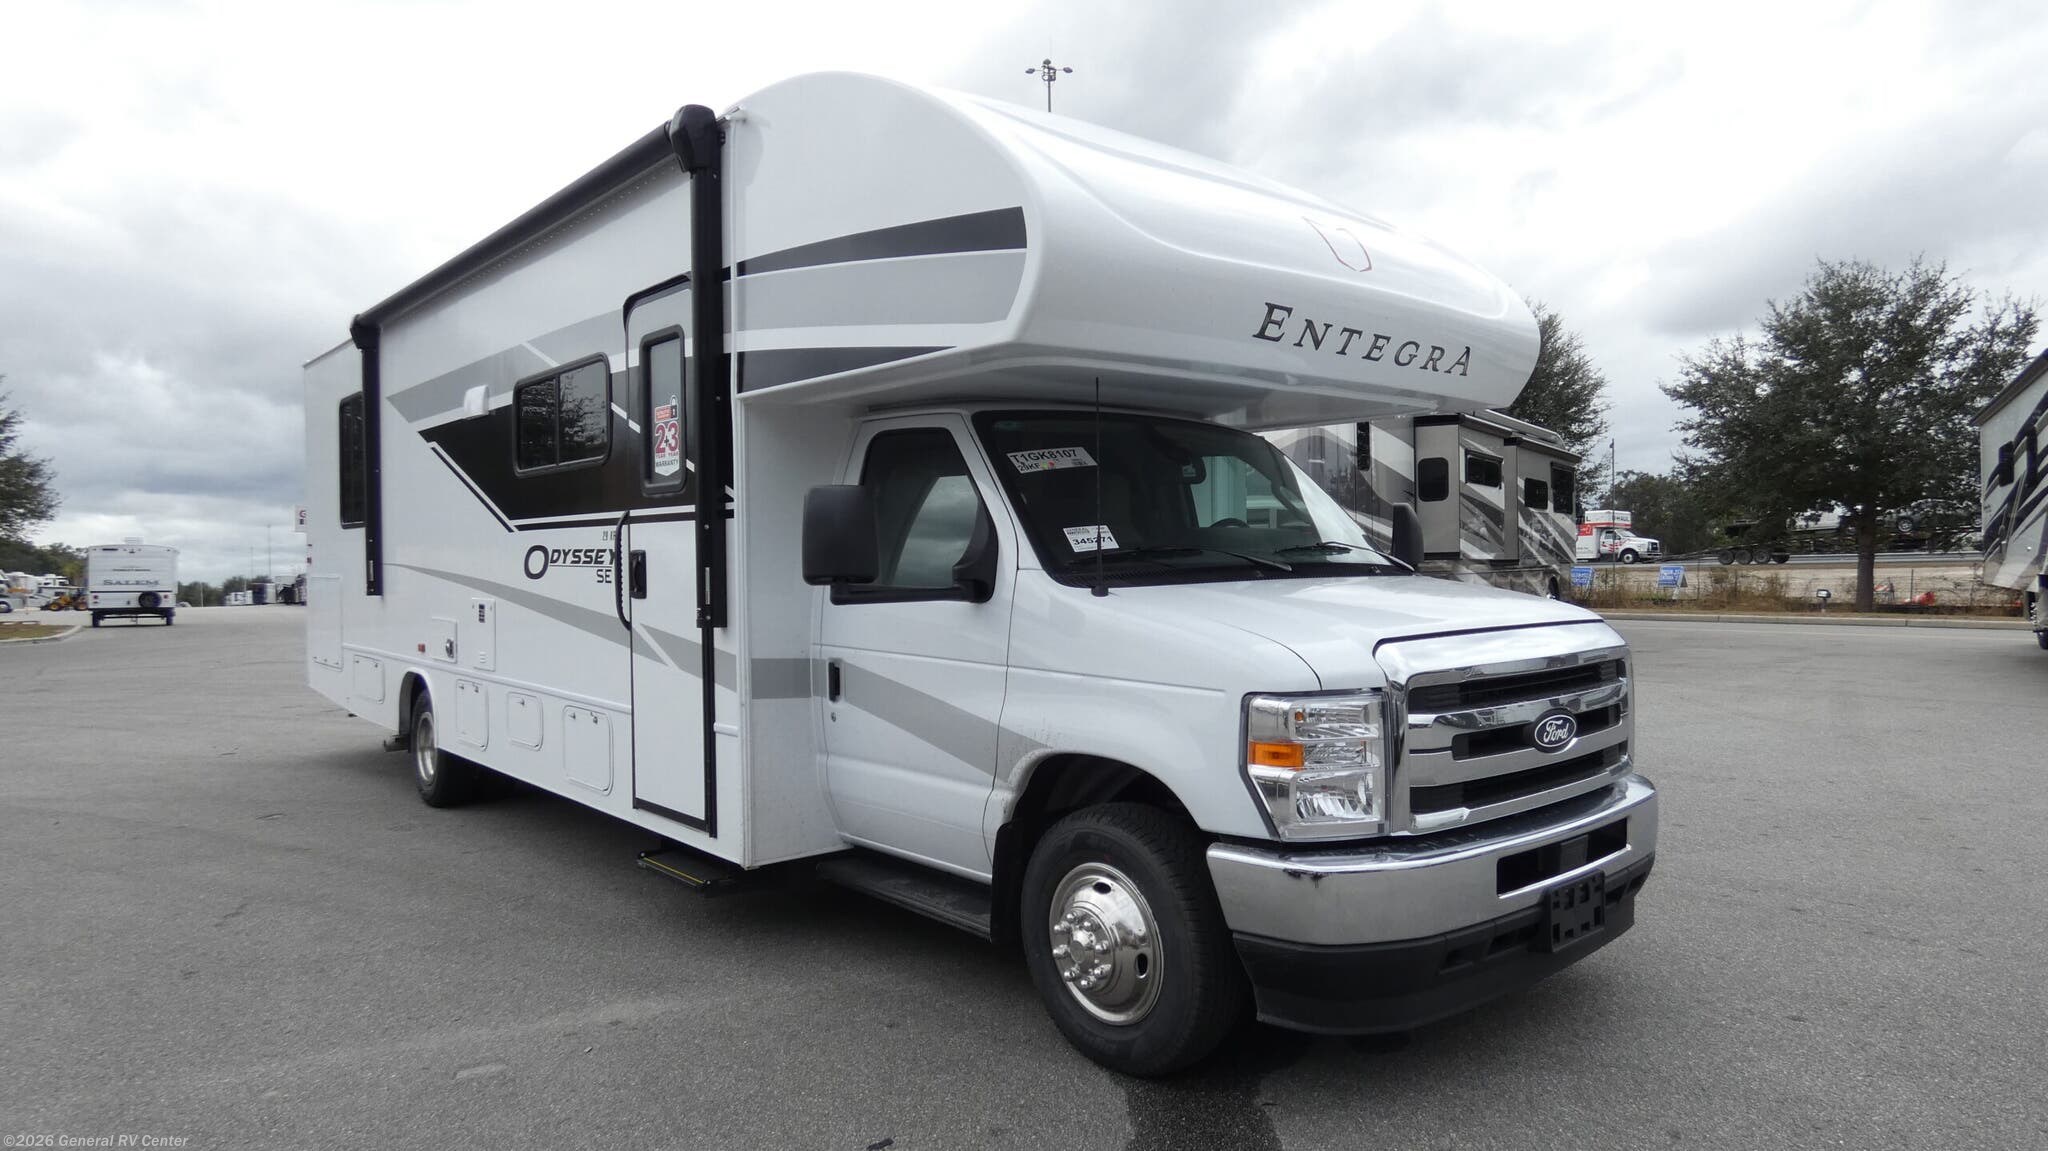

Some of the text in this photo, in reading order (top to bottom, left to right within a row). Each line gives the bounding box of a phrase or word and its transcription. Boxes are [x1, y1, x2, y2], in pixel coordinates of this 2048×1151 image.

[1252, 302, 1471, 376] ENTEGRA
[1010, 449, 1078, 463] T1GK8107
[596, 569, 612, 583] SE
[1543, 719, 1569, 743] Ford
